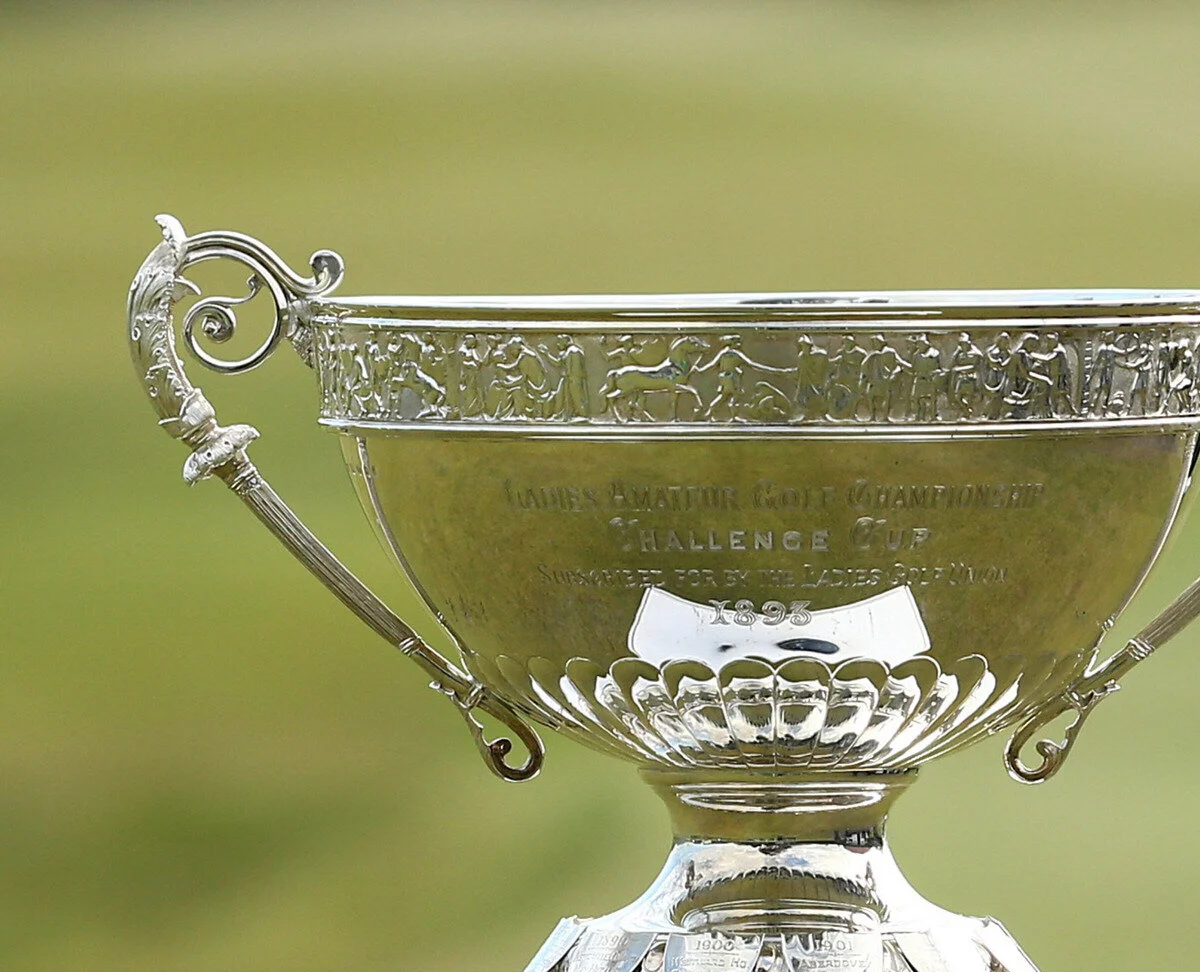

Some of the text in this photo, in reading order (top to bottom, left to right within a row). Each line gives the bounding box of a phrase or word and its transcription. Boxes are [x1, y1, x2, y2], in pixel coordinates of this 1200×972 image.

[608, 516, 931, 552] CHALLENGE CUP
[708, 599, 813, 626] 1893
